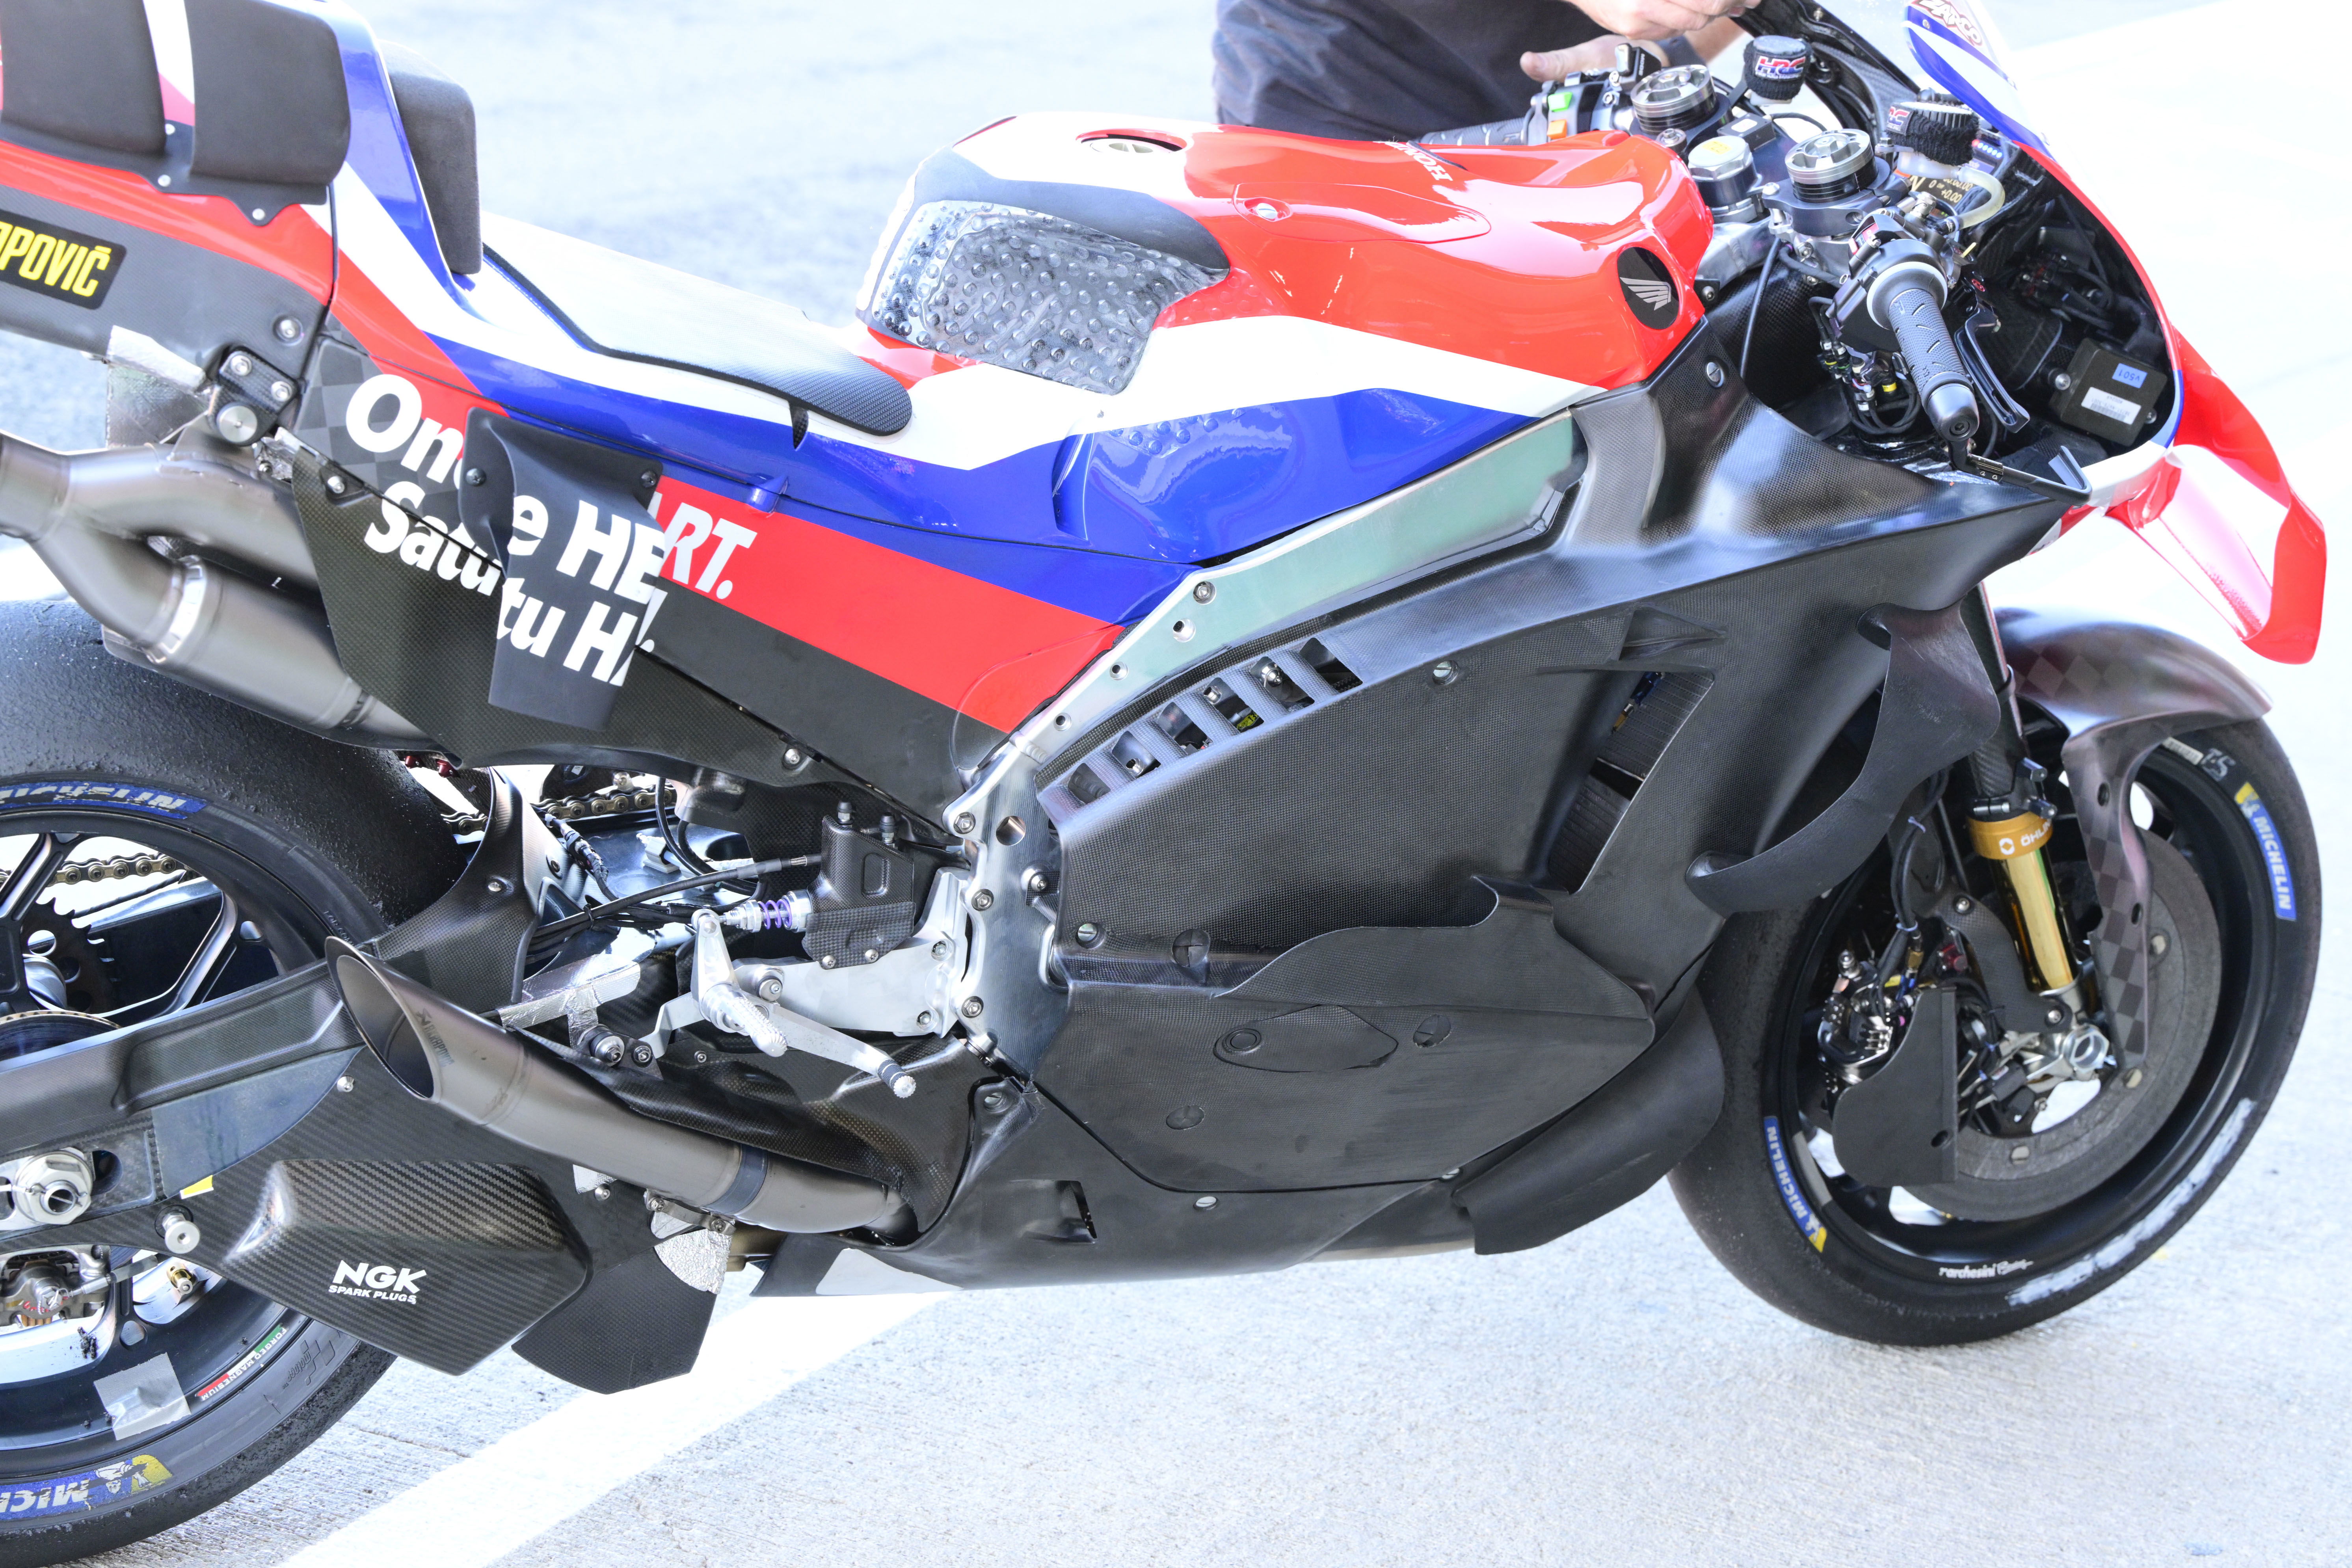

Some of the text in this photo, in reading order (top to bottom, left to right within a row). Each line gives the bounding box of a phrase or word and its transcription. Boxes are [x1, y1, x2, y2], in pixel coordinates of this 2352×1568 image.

[1755, 56, 1806, 75] HRC
[2253, 816, 2292, 910] MICHELIN
[1767, 1126, 1808, 1218] MICHELIN
[328, 1285, 417, 1303] SPARK PLUGS
[332, 1259, 427, 1294] NGK
[201, 1327, 287, 1401] FORGED MAGNESIUM
